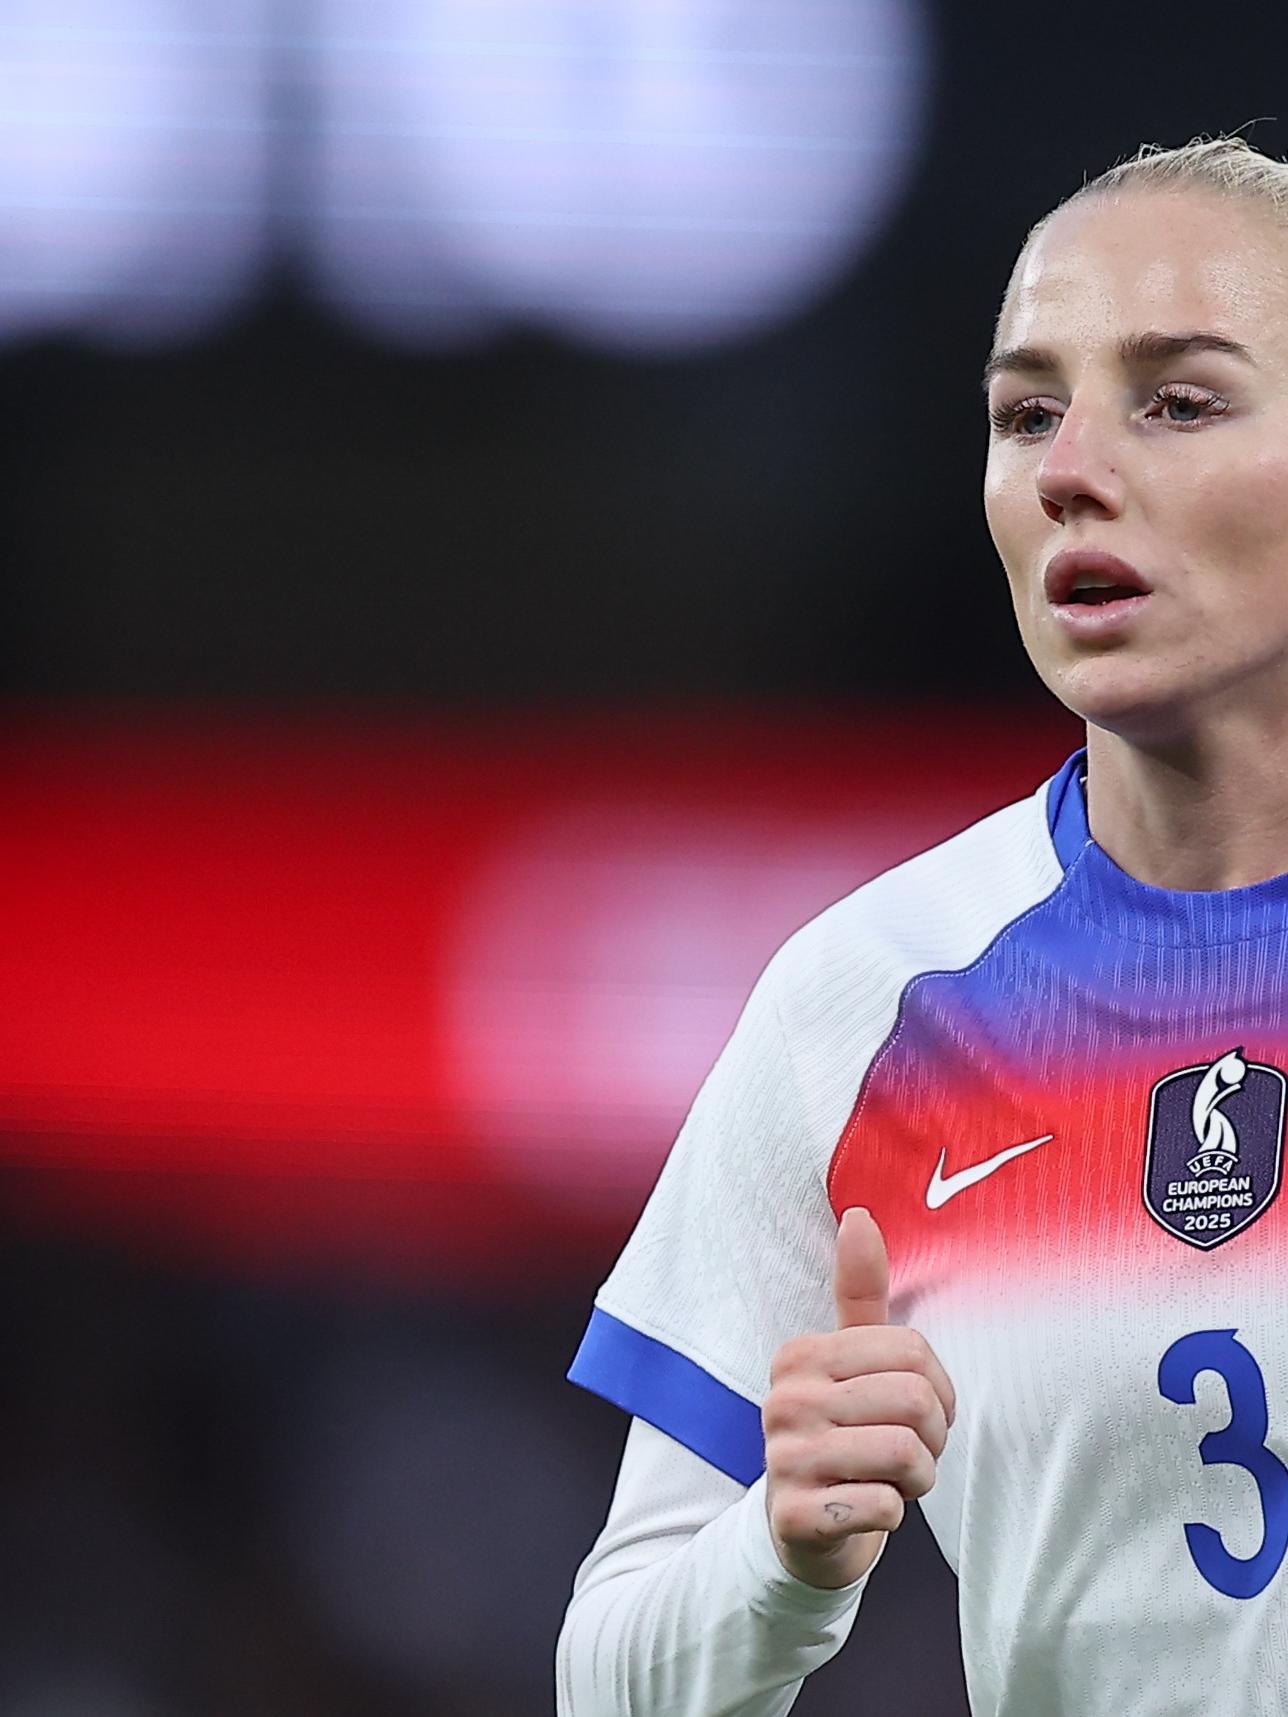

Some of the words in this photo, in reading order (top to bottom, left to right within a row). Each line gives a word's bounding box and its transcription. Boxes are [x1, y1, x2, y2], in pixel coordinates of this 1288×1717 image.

[1188, 1155, 1234, 1173] UEFA
[1168, 1176, 1250, 1196] EUROPEAN
[1162, 1193, 1253, 1212] CHAMPIONS
[1184, 1213, 1231, 1231] 2025
